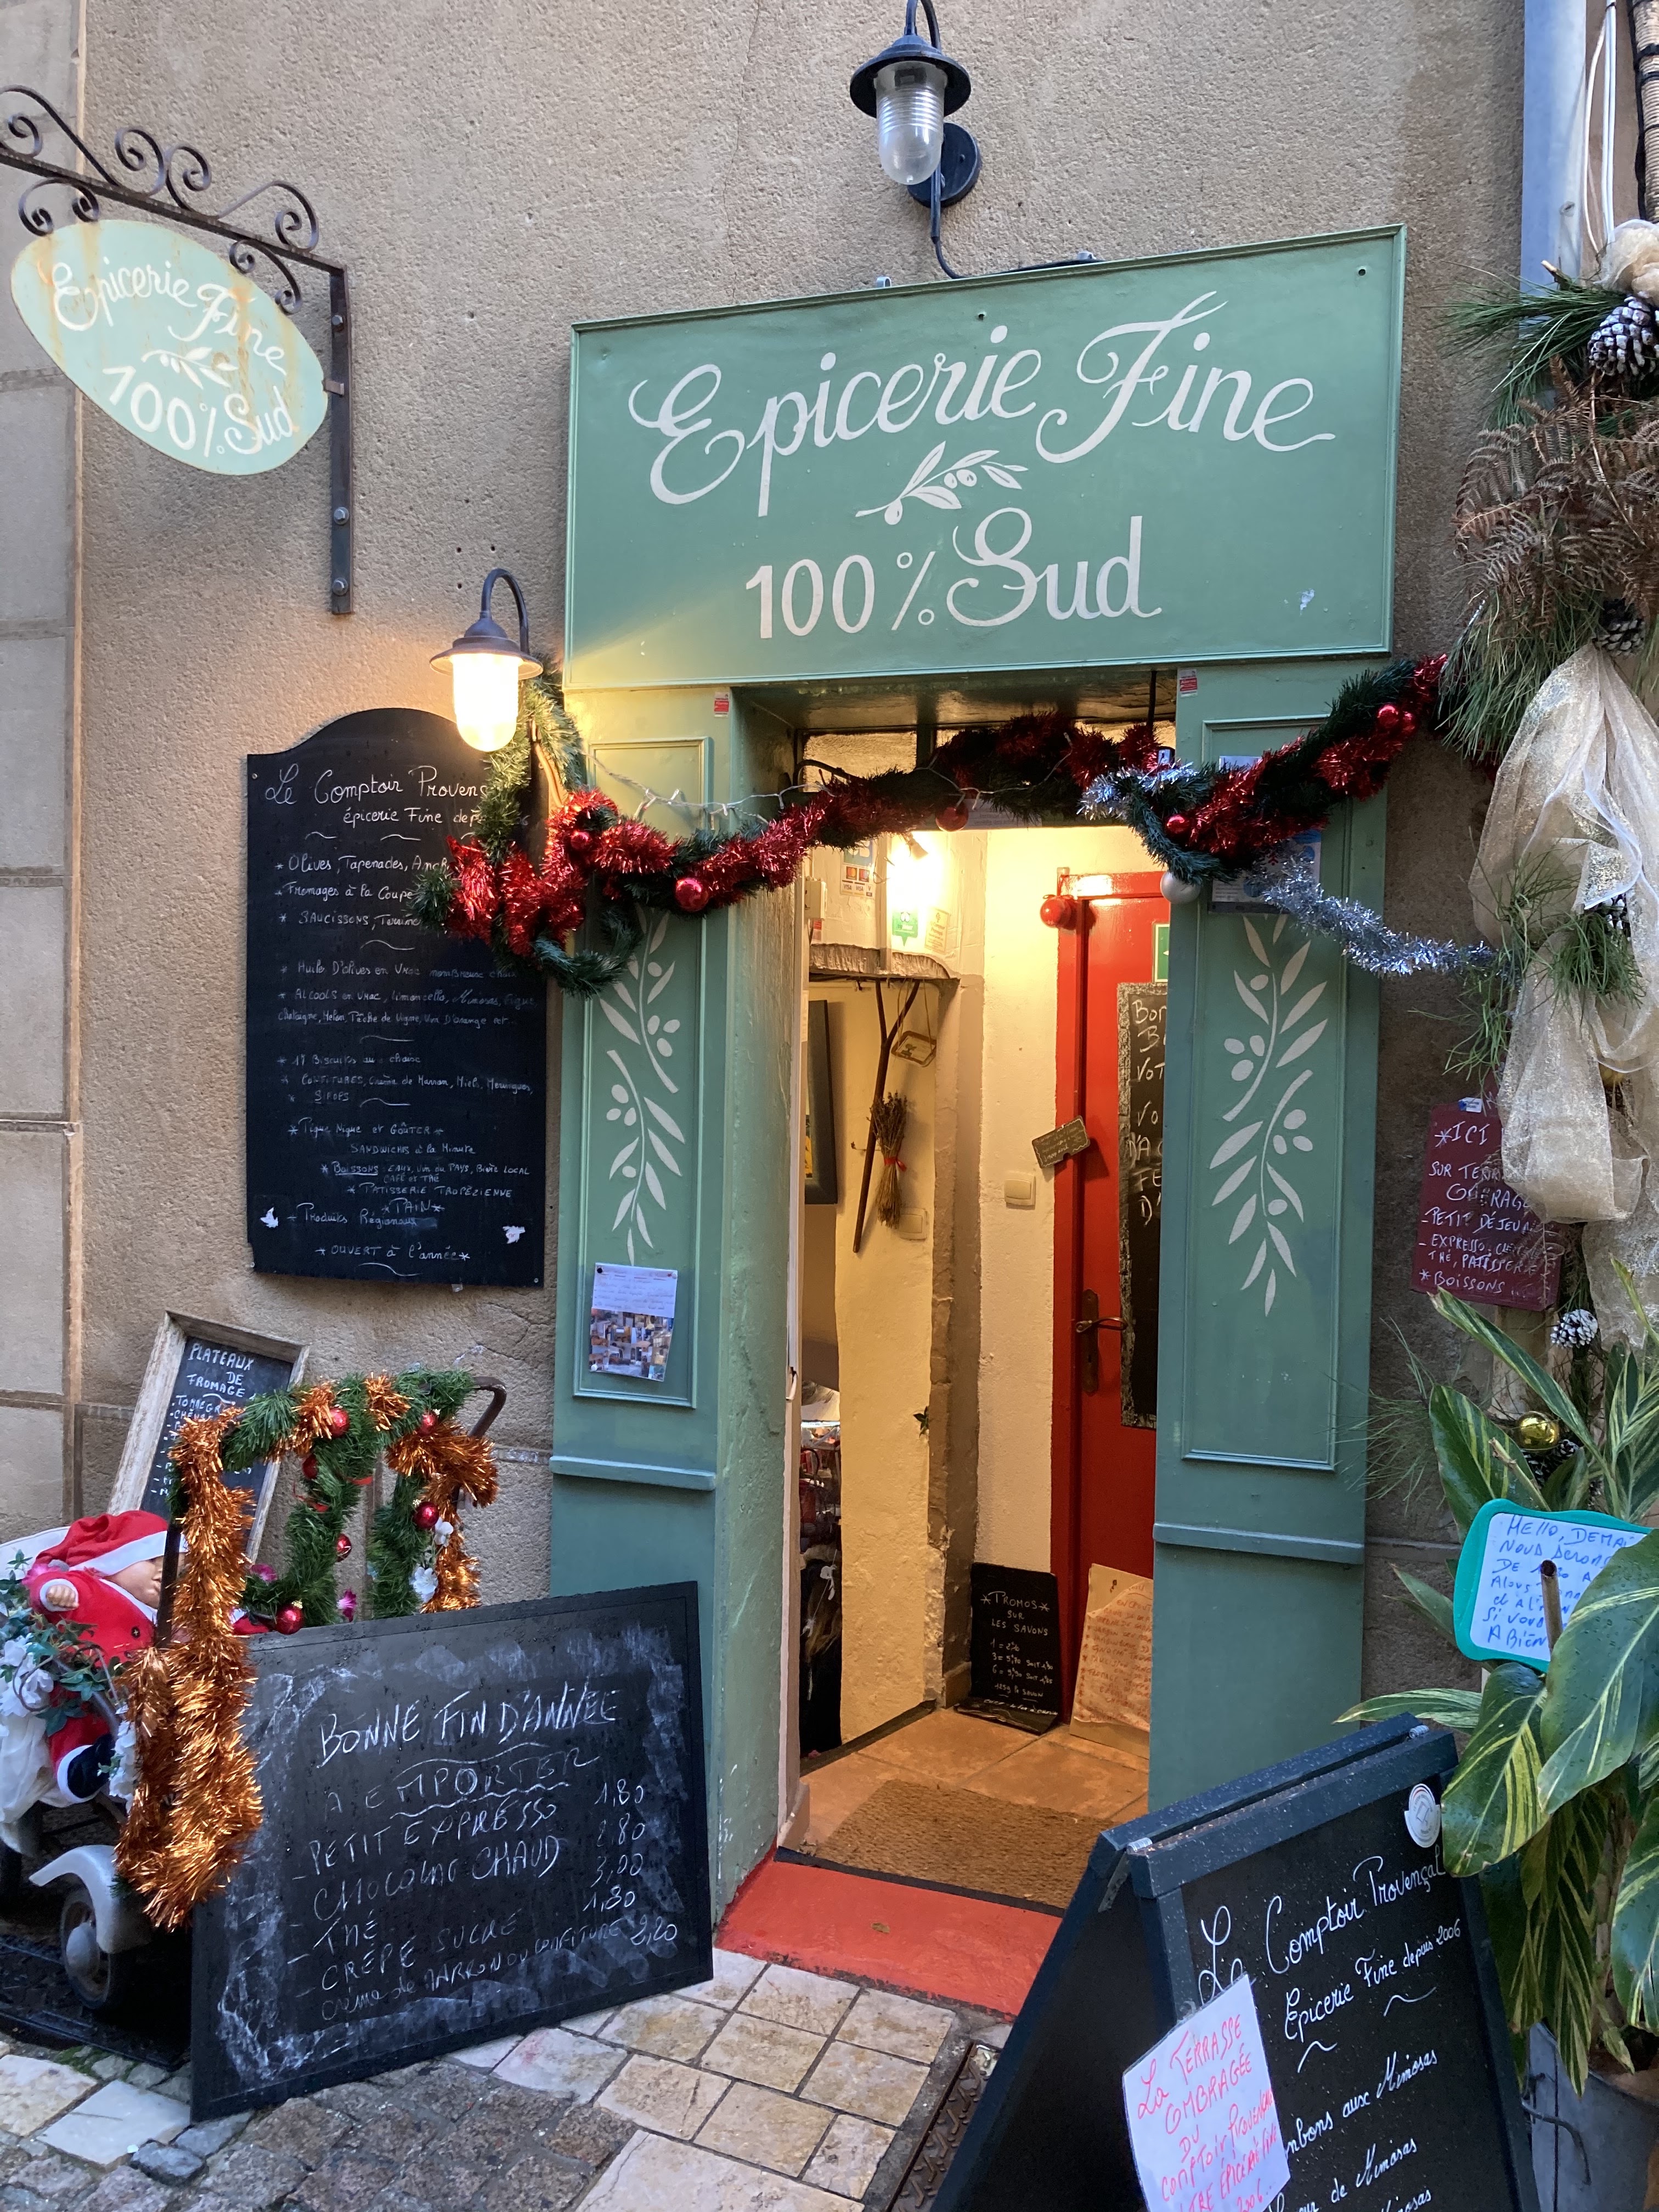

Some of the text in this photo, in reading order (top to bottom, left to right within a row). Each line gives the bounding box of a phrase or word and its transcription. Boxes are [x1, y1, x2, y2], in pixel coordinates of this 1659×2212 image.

[37, 256, 287, 376] Epicerie Fine
[628, 291, 1336, 517] Epicerie Fine
[224, 385, 299, 455] Sud
[947, 507, 1162, 628] Sud
[265, 763, 404, 805] Le Comptoir
[404, 807, 443, 823] Fine
[282, 881, 340, 902] Fromages
[345, 884, 357, 896] à
[360, 883, 374, 898] la
[298, 959, 325, 974] Huile
[374, 967, 388, 975] en
[381, 1012, 391, 1023] de
[402, 1074, 413, 1086] de
[426, 1143, 437, 1154] la
[504, 1165, 532, 1176] LOCAL
[1429, 1161, 1452, 1177] SUR
[1424, 1206, 1472, 1227] PETIT
[330, 1245, 383, 1256] OUVERT
[386, 1244, 401, 1257] à
[188, 1342, 255, 1372] PLATEAUX
[186, 1373, 246, 1398] FROMAGE
[225, 1371, 244, 1386] DE
[1492, 1559, 1520, 1573] DE
[988, 1590, 1037, 1610] PROMOS
[991, 1618, 1048, 1637] LES SAVONS
[1007, 1610, 1025, 1620] SUR
[1487, 1624, 1501, 1644] A
[316, 1700, 420, 1769] BONNE
[433, 1690, 487, 1740] FIN
[308, 1825, 392, 1876] PETIT
[594, 1778, 644, 1808] 1,80
[471, 1835, 560, 1881] CHAUD
[582, 1884, 636, 1912] 1,80
[1266, 1895, 1365, 1975] Comptoir
[1353, 1844, 1447, 1907] Provençal
[312, 1909, 379, 1956] THÉ
[630, 1914, 678, 1946] 2,20
[1284, 1918, 1462, 2043] Epicerie Fine depuis 2006
[1137, 2014, 1242, 2120] La TERRASSE
[1165, 2042, 1252, 2135] OMBRAGÉE
[1342, 2049, 1437, 2118] aux Mimosas
[1179, 2124, 1199, 2163] DU
[1331, 2177, 1348, 2203] de
[1356, 2138, 1418, 2188] Mimosas
